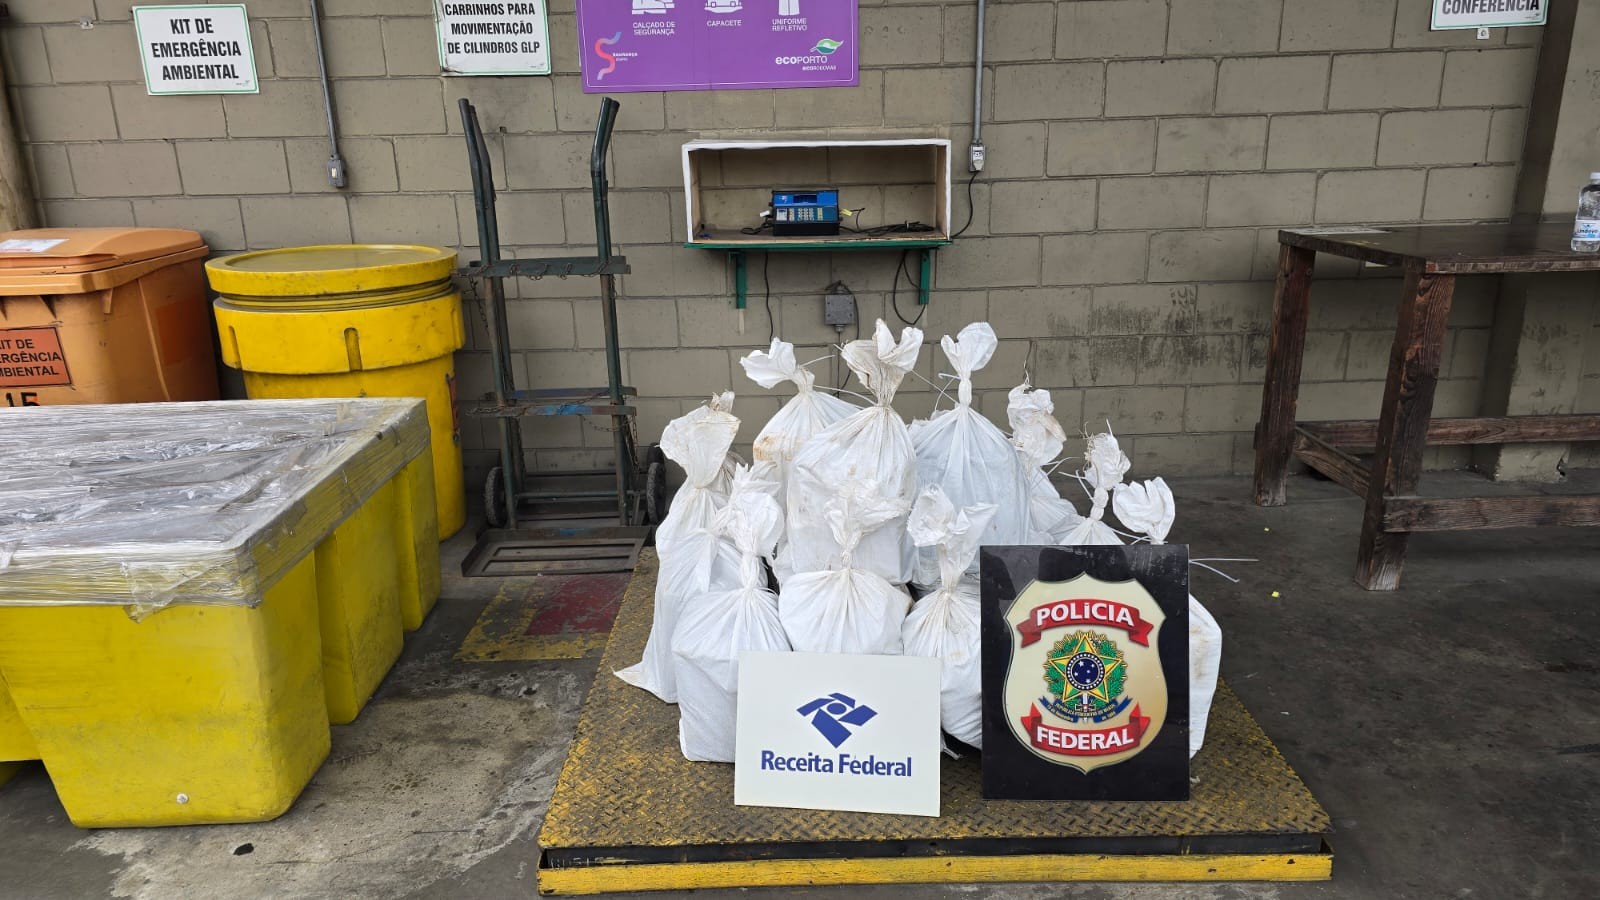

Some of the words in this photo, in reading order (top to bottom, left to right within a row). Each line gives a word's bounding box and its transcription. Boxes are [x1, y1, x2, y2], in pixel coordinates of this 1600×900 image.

[445, 4, 505, 16] CARRINHOS
[507, 3, 535, 15] PARA
[170, 19, 191, 34] KIT
[195, 18, 214, 34] DE
[451, 21, 533, 36] MOVIMENTAÇÃO
[772, 24, 808, 32] REFLETIVO
[151, 39, 242, 58] EMERGÊNCIA
[447, 42, 461, 54] DE
[463, 42, 518, 54] CILINDROS
[521, 41, 540, 53] GLP
[162, 64, 240, 80] AMBIENTAL
[0, 339, 11, 349] IT
[15, 339, 35, 349] DE
[0, 351, 62, 363] RGÊNCIA
[1036, 725, 1134, 750] FEDERAL
[760, 750, 834, 773] Receita
[838, 753, 912, 777] Federal
